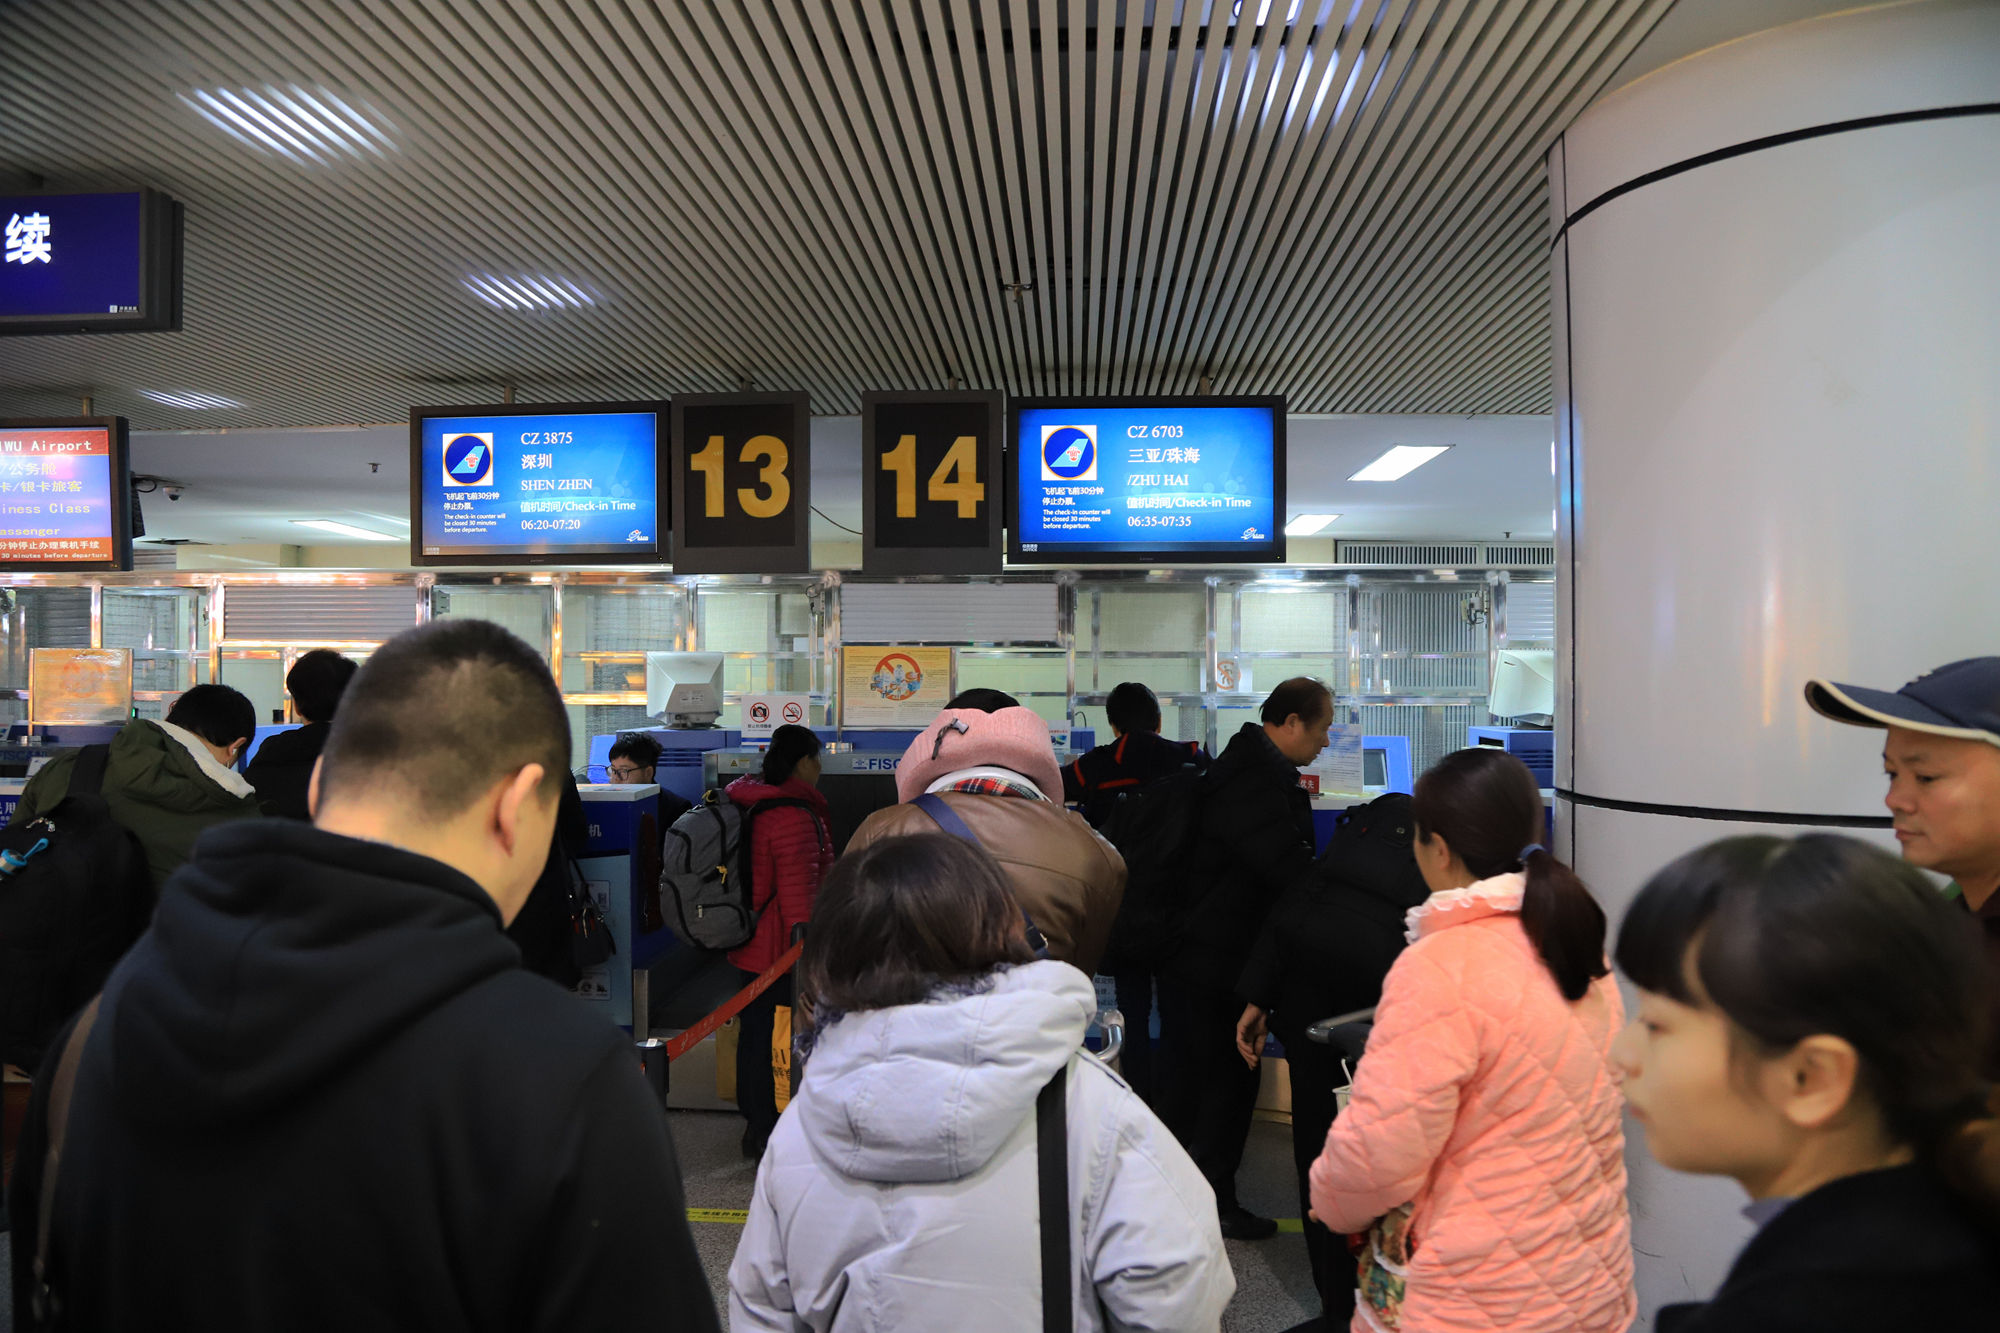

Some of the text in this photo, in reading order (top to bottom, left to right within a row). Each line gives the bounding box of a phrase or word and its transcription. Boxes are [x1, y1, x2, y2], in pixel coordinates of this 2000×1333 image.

[5, 212, 51, 264] 续
[1127, 425, 1184, 438] CZ 6703
[520, 432, 573, 444] CZ 3875
[31, 440, 92, 453] Airport
[521, 453, 552, 469] 深圳
[1127, 447, 1200, 463] 三亚/珠海
[690, 434, 791, 518] 13
[881, 434, 985, 518] 14
[1127, 474, 1189, 486] /ZHU HAI
[521, 479, 593, 490] SHEN ZHEN
[49, 503, 90, 513] Class
[610, 500, 637, 511] Time
[1223, 496, 1252, 508] Time
[521, 520, 581, 530] 06:20-07:20
[1127, 516, 1192, 527] 06:35-07:35
